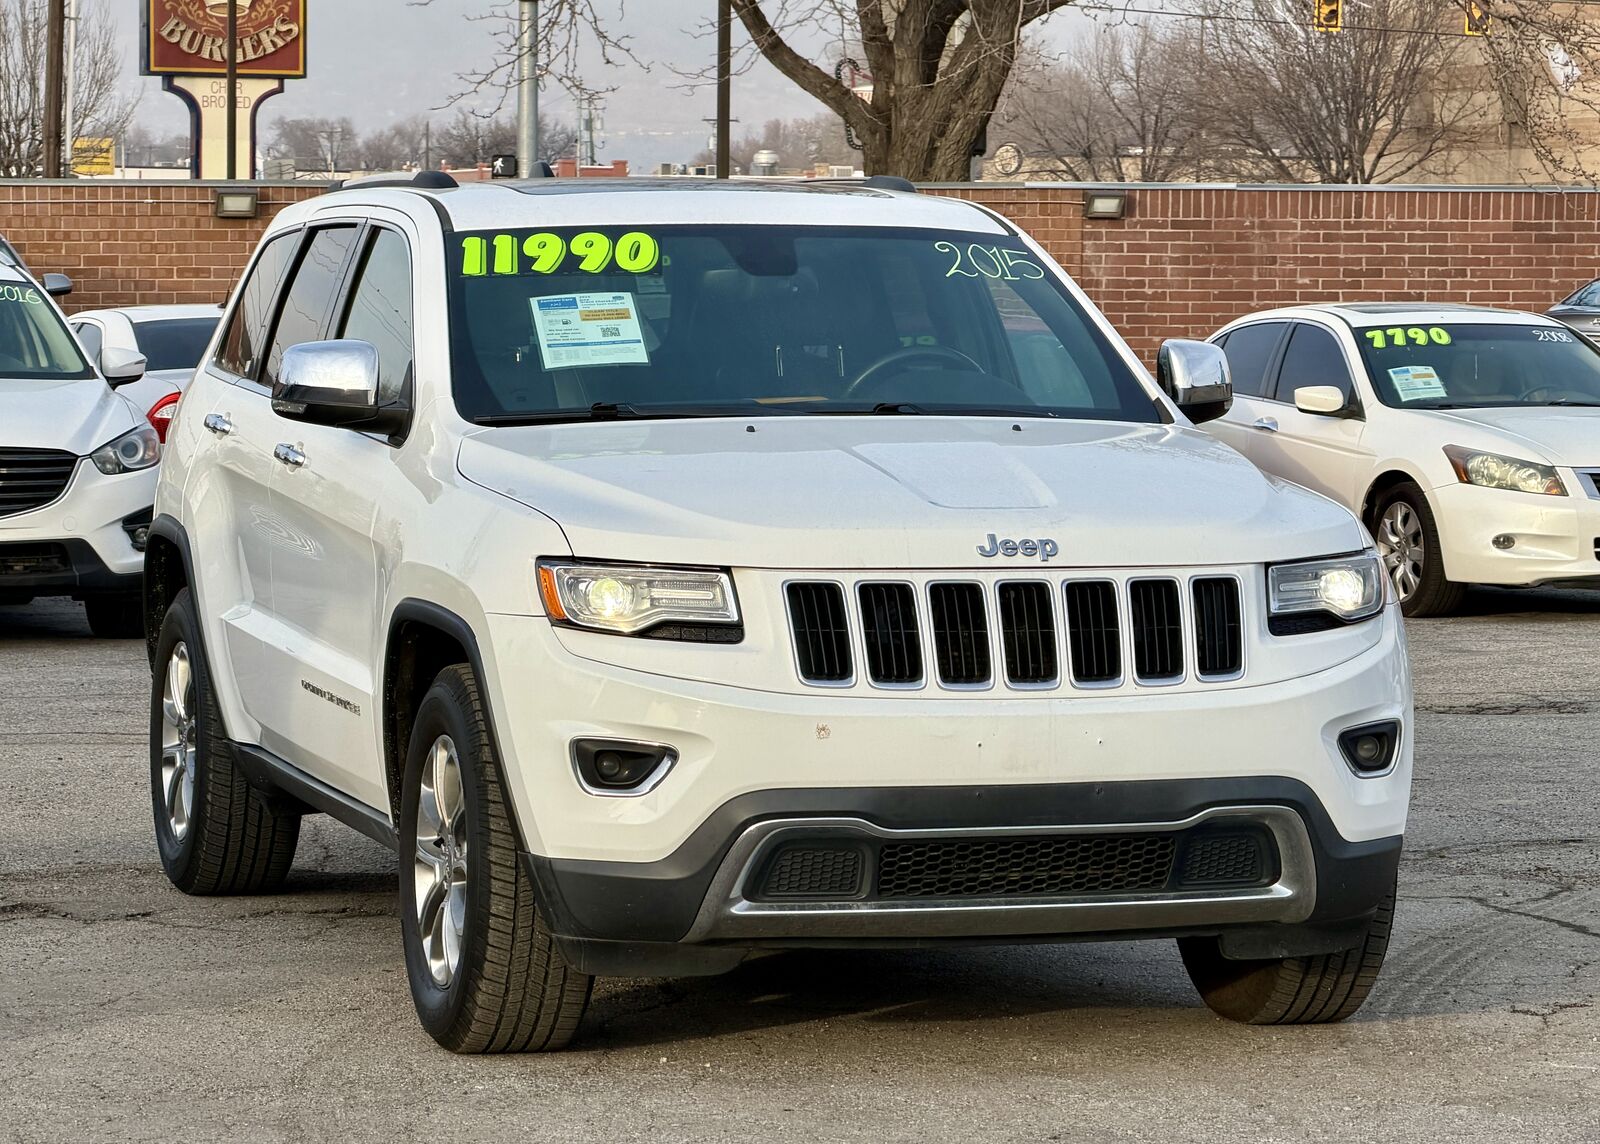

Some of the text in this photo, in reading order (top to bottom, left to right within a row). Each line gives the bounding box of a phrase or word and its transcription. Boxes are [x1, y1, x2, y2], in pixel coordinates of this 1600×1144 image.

[160, 13, 299, 63] BURGERS
[202, 95, 251, 108] BROED
[211, 81, 243, 94] CHR
[462, 232, 659, 276] 11990
[934, 241, 1044, 280] 2015
[1365, 327, 1452, 348] 7790
[976, 533, 1058, 561] Jeep
